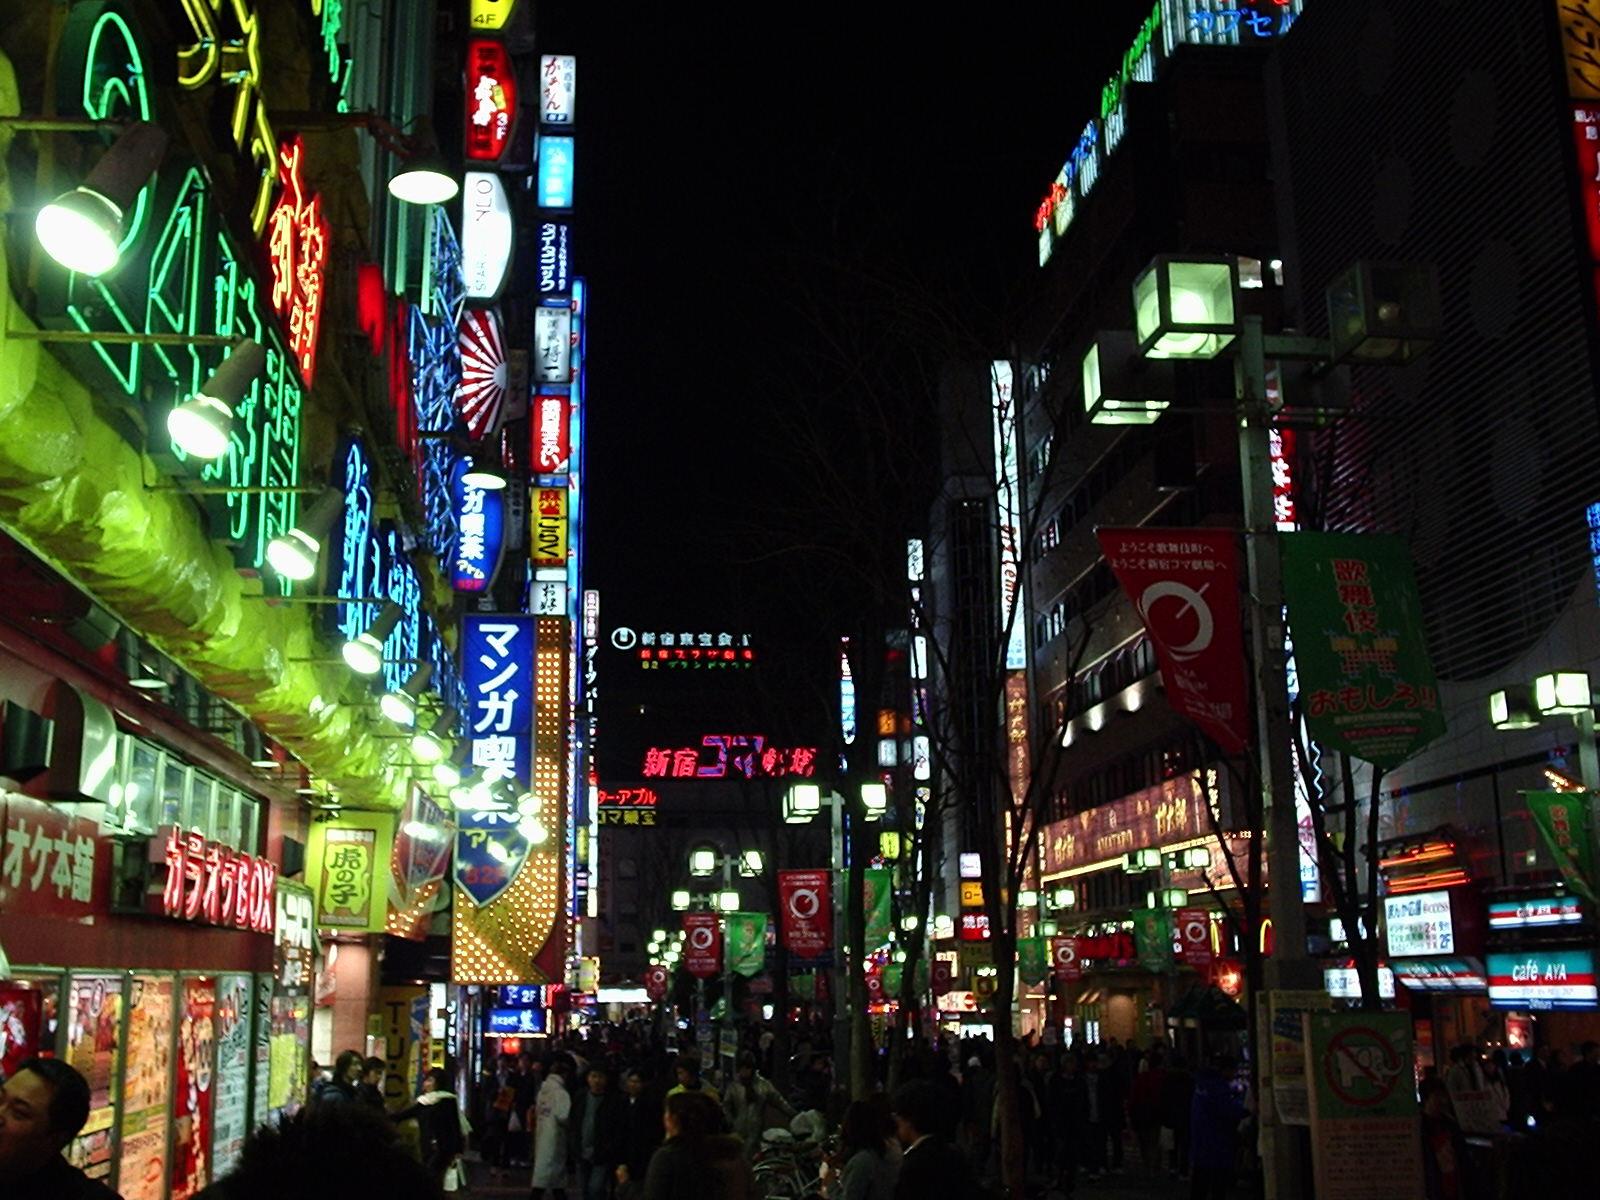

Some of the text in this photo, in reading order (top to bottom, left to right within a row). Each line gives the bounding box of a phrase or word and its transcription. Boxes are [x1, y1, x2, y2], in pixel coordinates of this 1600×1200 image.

[473, 14, 497, 25] 4F
[1512, 959, 1567, 982] café AYA
